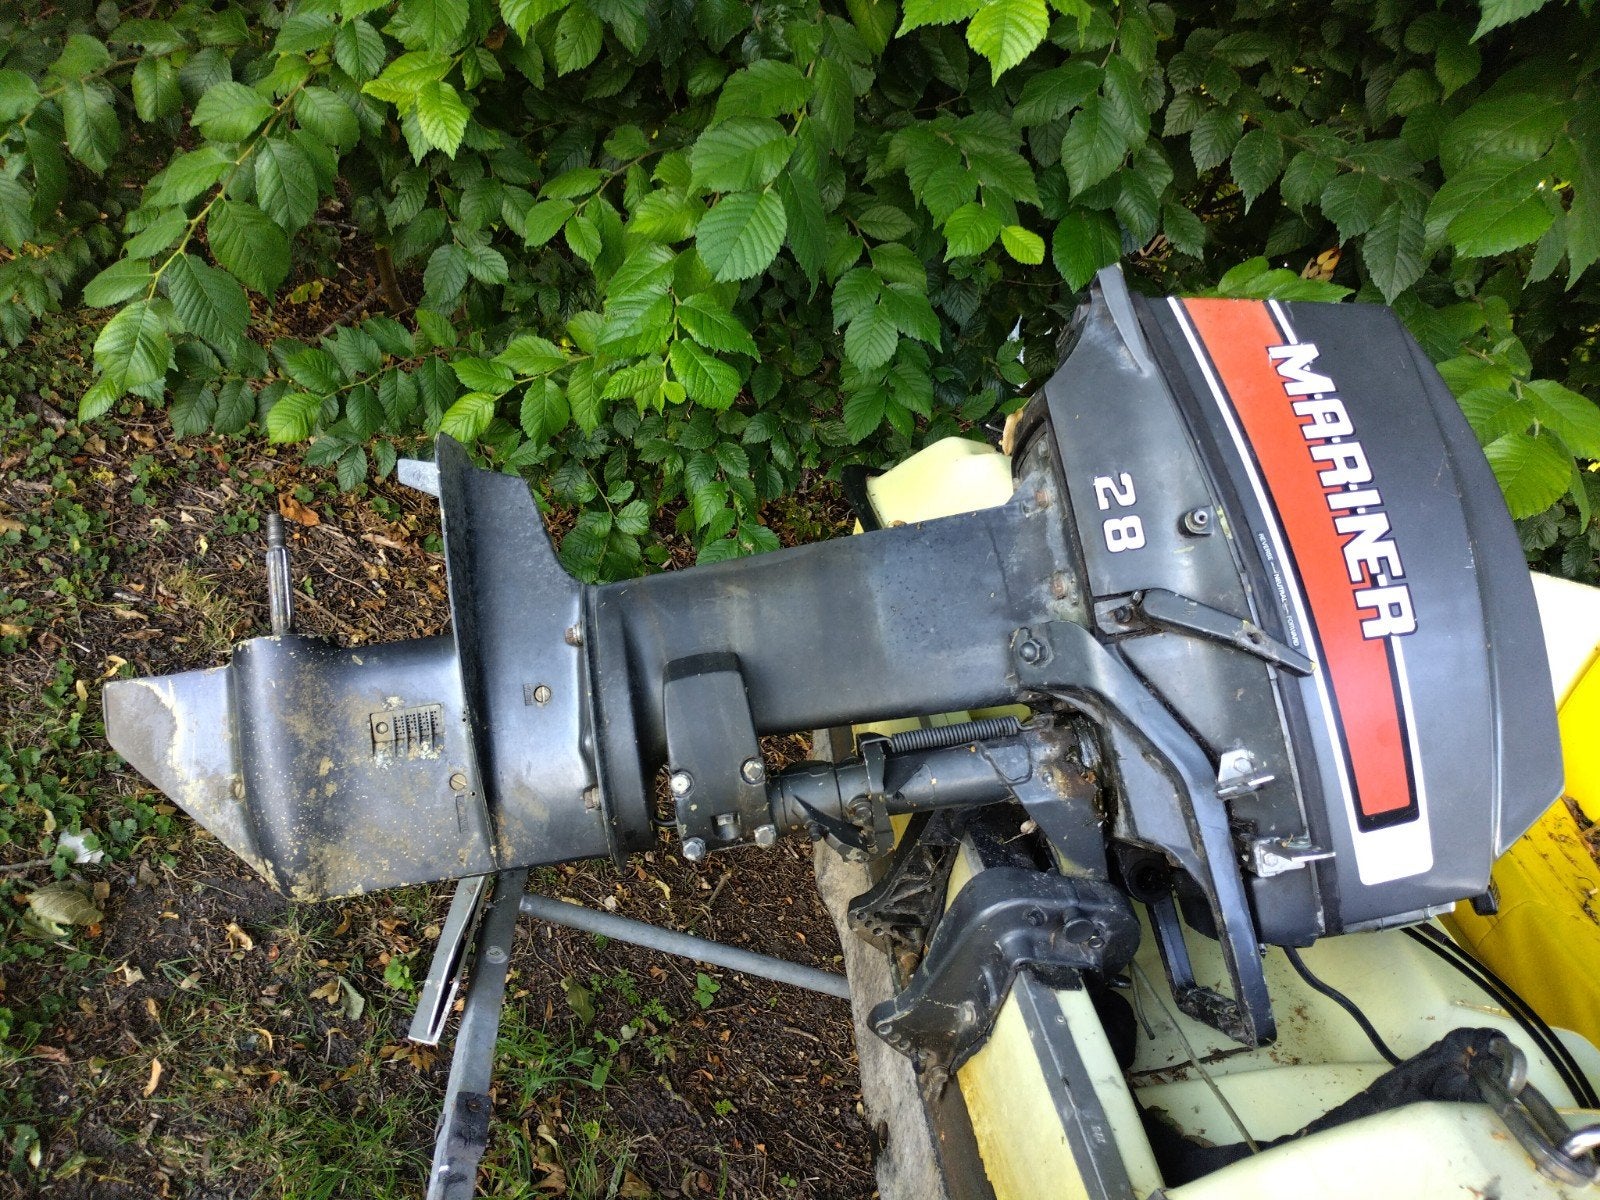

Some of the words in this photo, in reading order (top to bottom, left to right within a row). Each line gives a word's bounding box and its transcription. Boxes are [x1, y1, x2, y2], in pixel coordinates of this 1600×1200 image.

[1093, 472, 1146, 553] 28
[1266, 342, 1418, 639] MARINER
[1258, 533, 1274, 561] REVERSE
[1274, 572, 1288, 602] NEUTRAL
[1287, 615, 1300, 647] FORWARD
